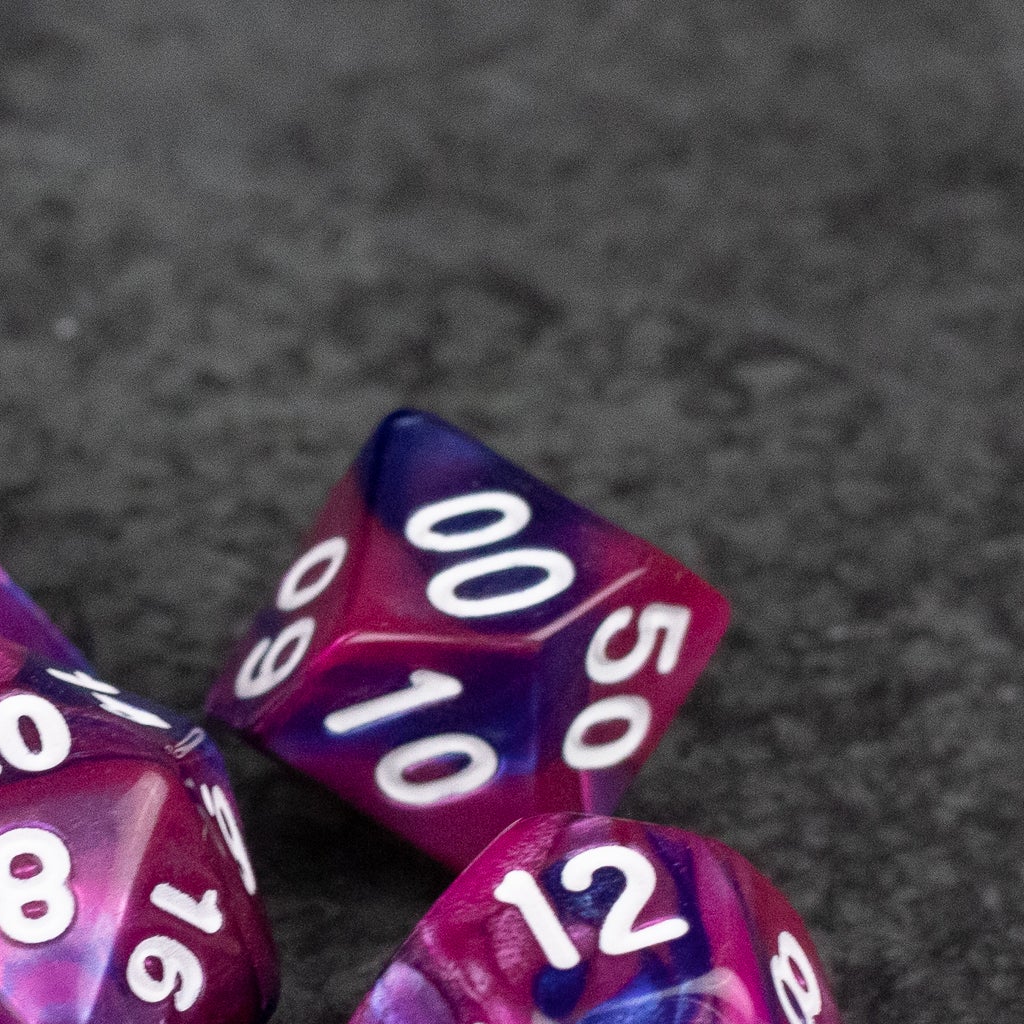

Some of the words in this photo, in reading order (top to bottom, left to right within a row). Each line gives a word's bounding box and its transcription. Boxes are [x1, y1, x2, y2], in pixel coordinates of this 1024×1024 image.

[405, 491, 575, 619] 00
[324, 671, 498, 806] 10
[562, 603, 690, 771] 50
[127, 882, 224, 1012] 16
[492, 843, 690, 972] 12
